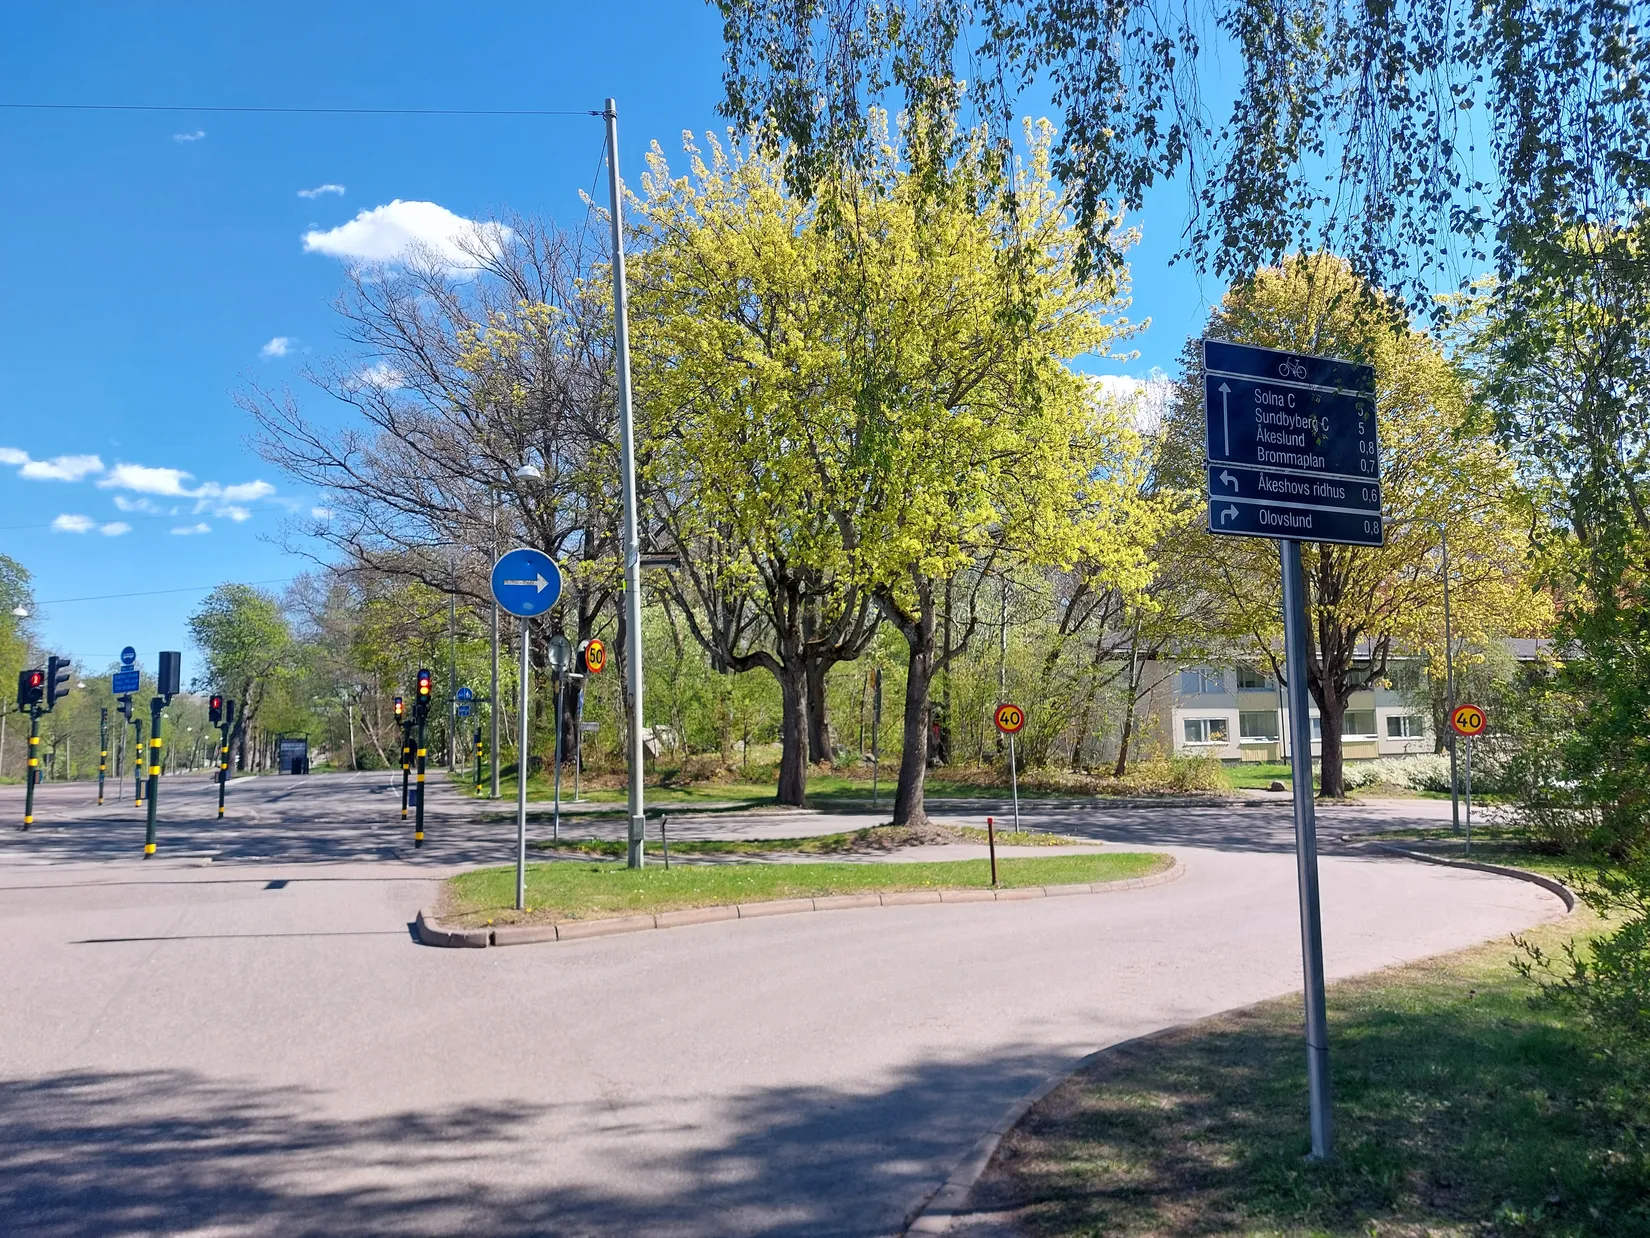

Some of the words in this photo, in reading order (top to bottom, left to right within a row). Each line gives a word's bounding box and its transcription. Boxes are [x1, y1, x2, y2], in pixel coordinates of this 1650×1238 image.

[1254, 388, 1285, 407] Solna
[1287, 393, 1296, 408] C
[1255, 407, 1319, 433] Sundbyberg
[1321, 416, 1329, 432] C
[1358, 421, 1365, 435] 5
[1256, 423, 1305, 447] Åkeslund
[1359, 440, 1375, 456] 0,8
[1257, 446, 1325, 469] Brommaplan
[1360, 458, 1376, 474] 0,7
[1258, 471, 1310, 496] Åkeshovs
[1313, 481, 1346, 499] ridhus
[1362, 487, 1378, 503] 0,6
[1259, 509, 1313, 529] Olovslund
[1363, 520, 1380, 536] 0,8
[590, 647, 603, 664] 50
[1000, 711, 1020, 725] 40
[1456, 712, 1481, 728] 40
